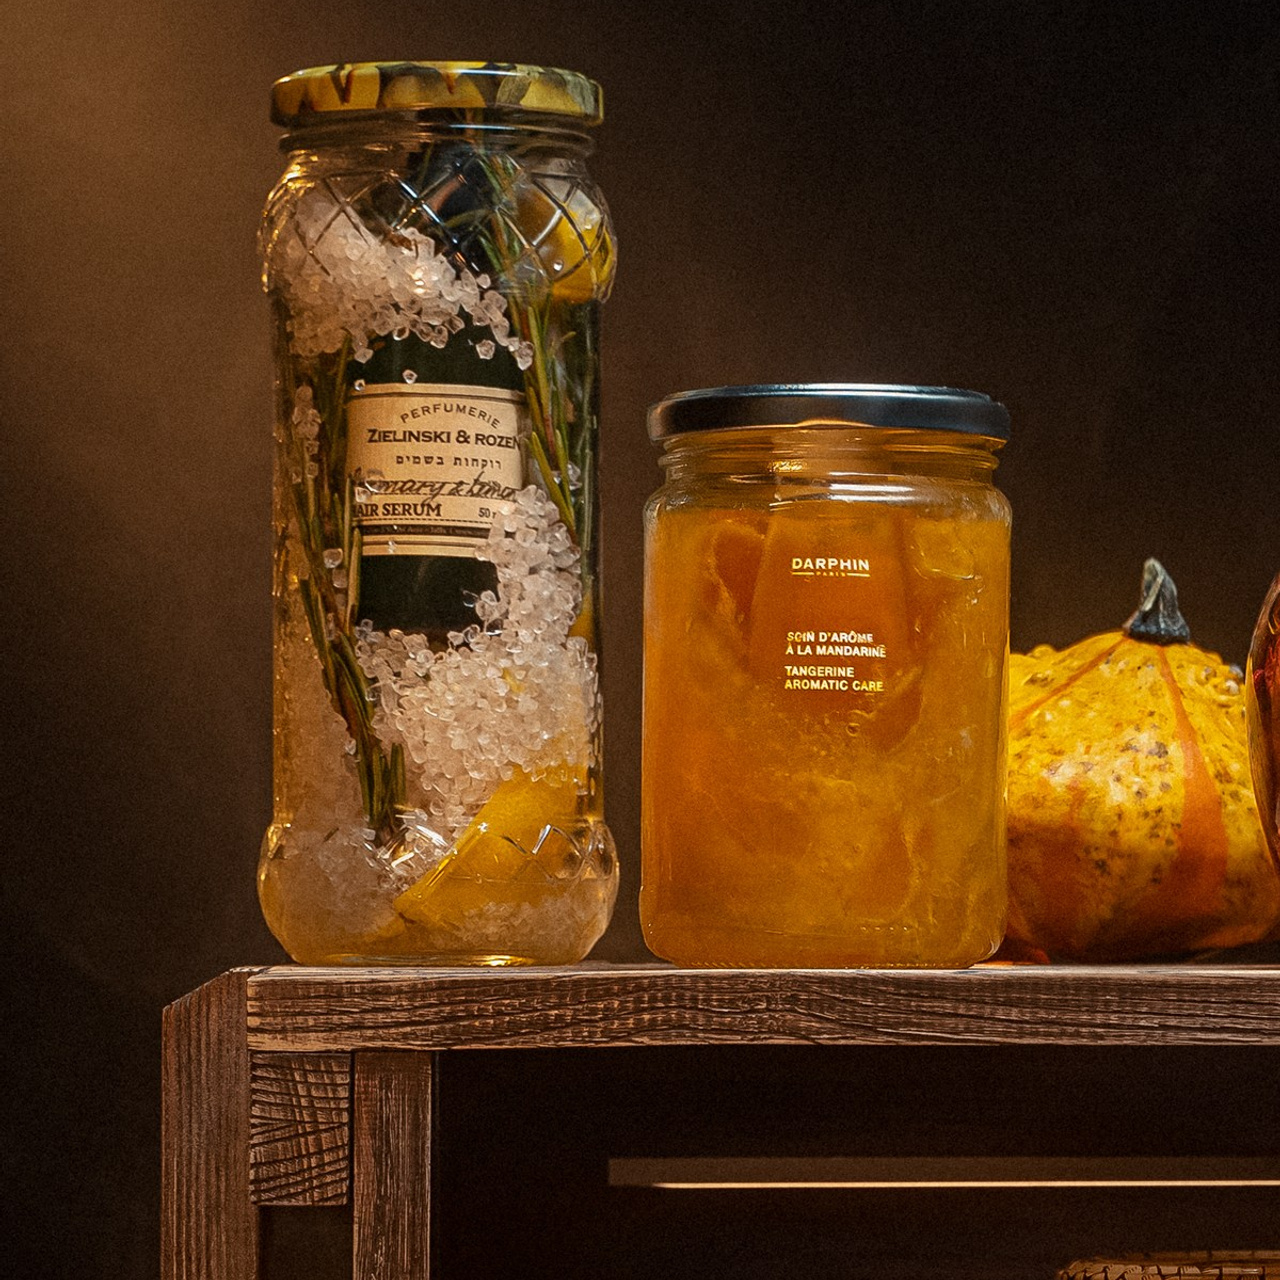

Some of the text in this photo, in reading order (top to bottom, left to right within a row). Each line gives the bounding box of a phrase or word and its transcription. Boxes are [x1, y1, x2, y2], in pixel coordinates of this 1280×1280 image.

[400, 403, 501, 429] PERFUMERIE
[367, 429, 521, 451] ZIELINSKI & ROZEN
[396, 455, 444, 465] בשמים
[354, 503, 379, 518] AIR
[382, 502, 443, 517] SERUM
[478, 507, 491, 519] 50
[792, 557, 870, 571] DARPHIN
[786, 630, 873, 643] SOIN D'ARÔME
[797, 645, 812, 655] LA
[785, 665, 855, 677] TANGERINE
[784, 679, 884, 692] AROMATIC CARE
